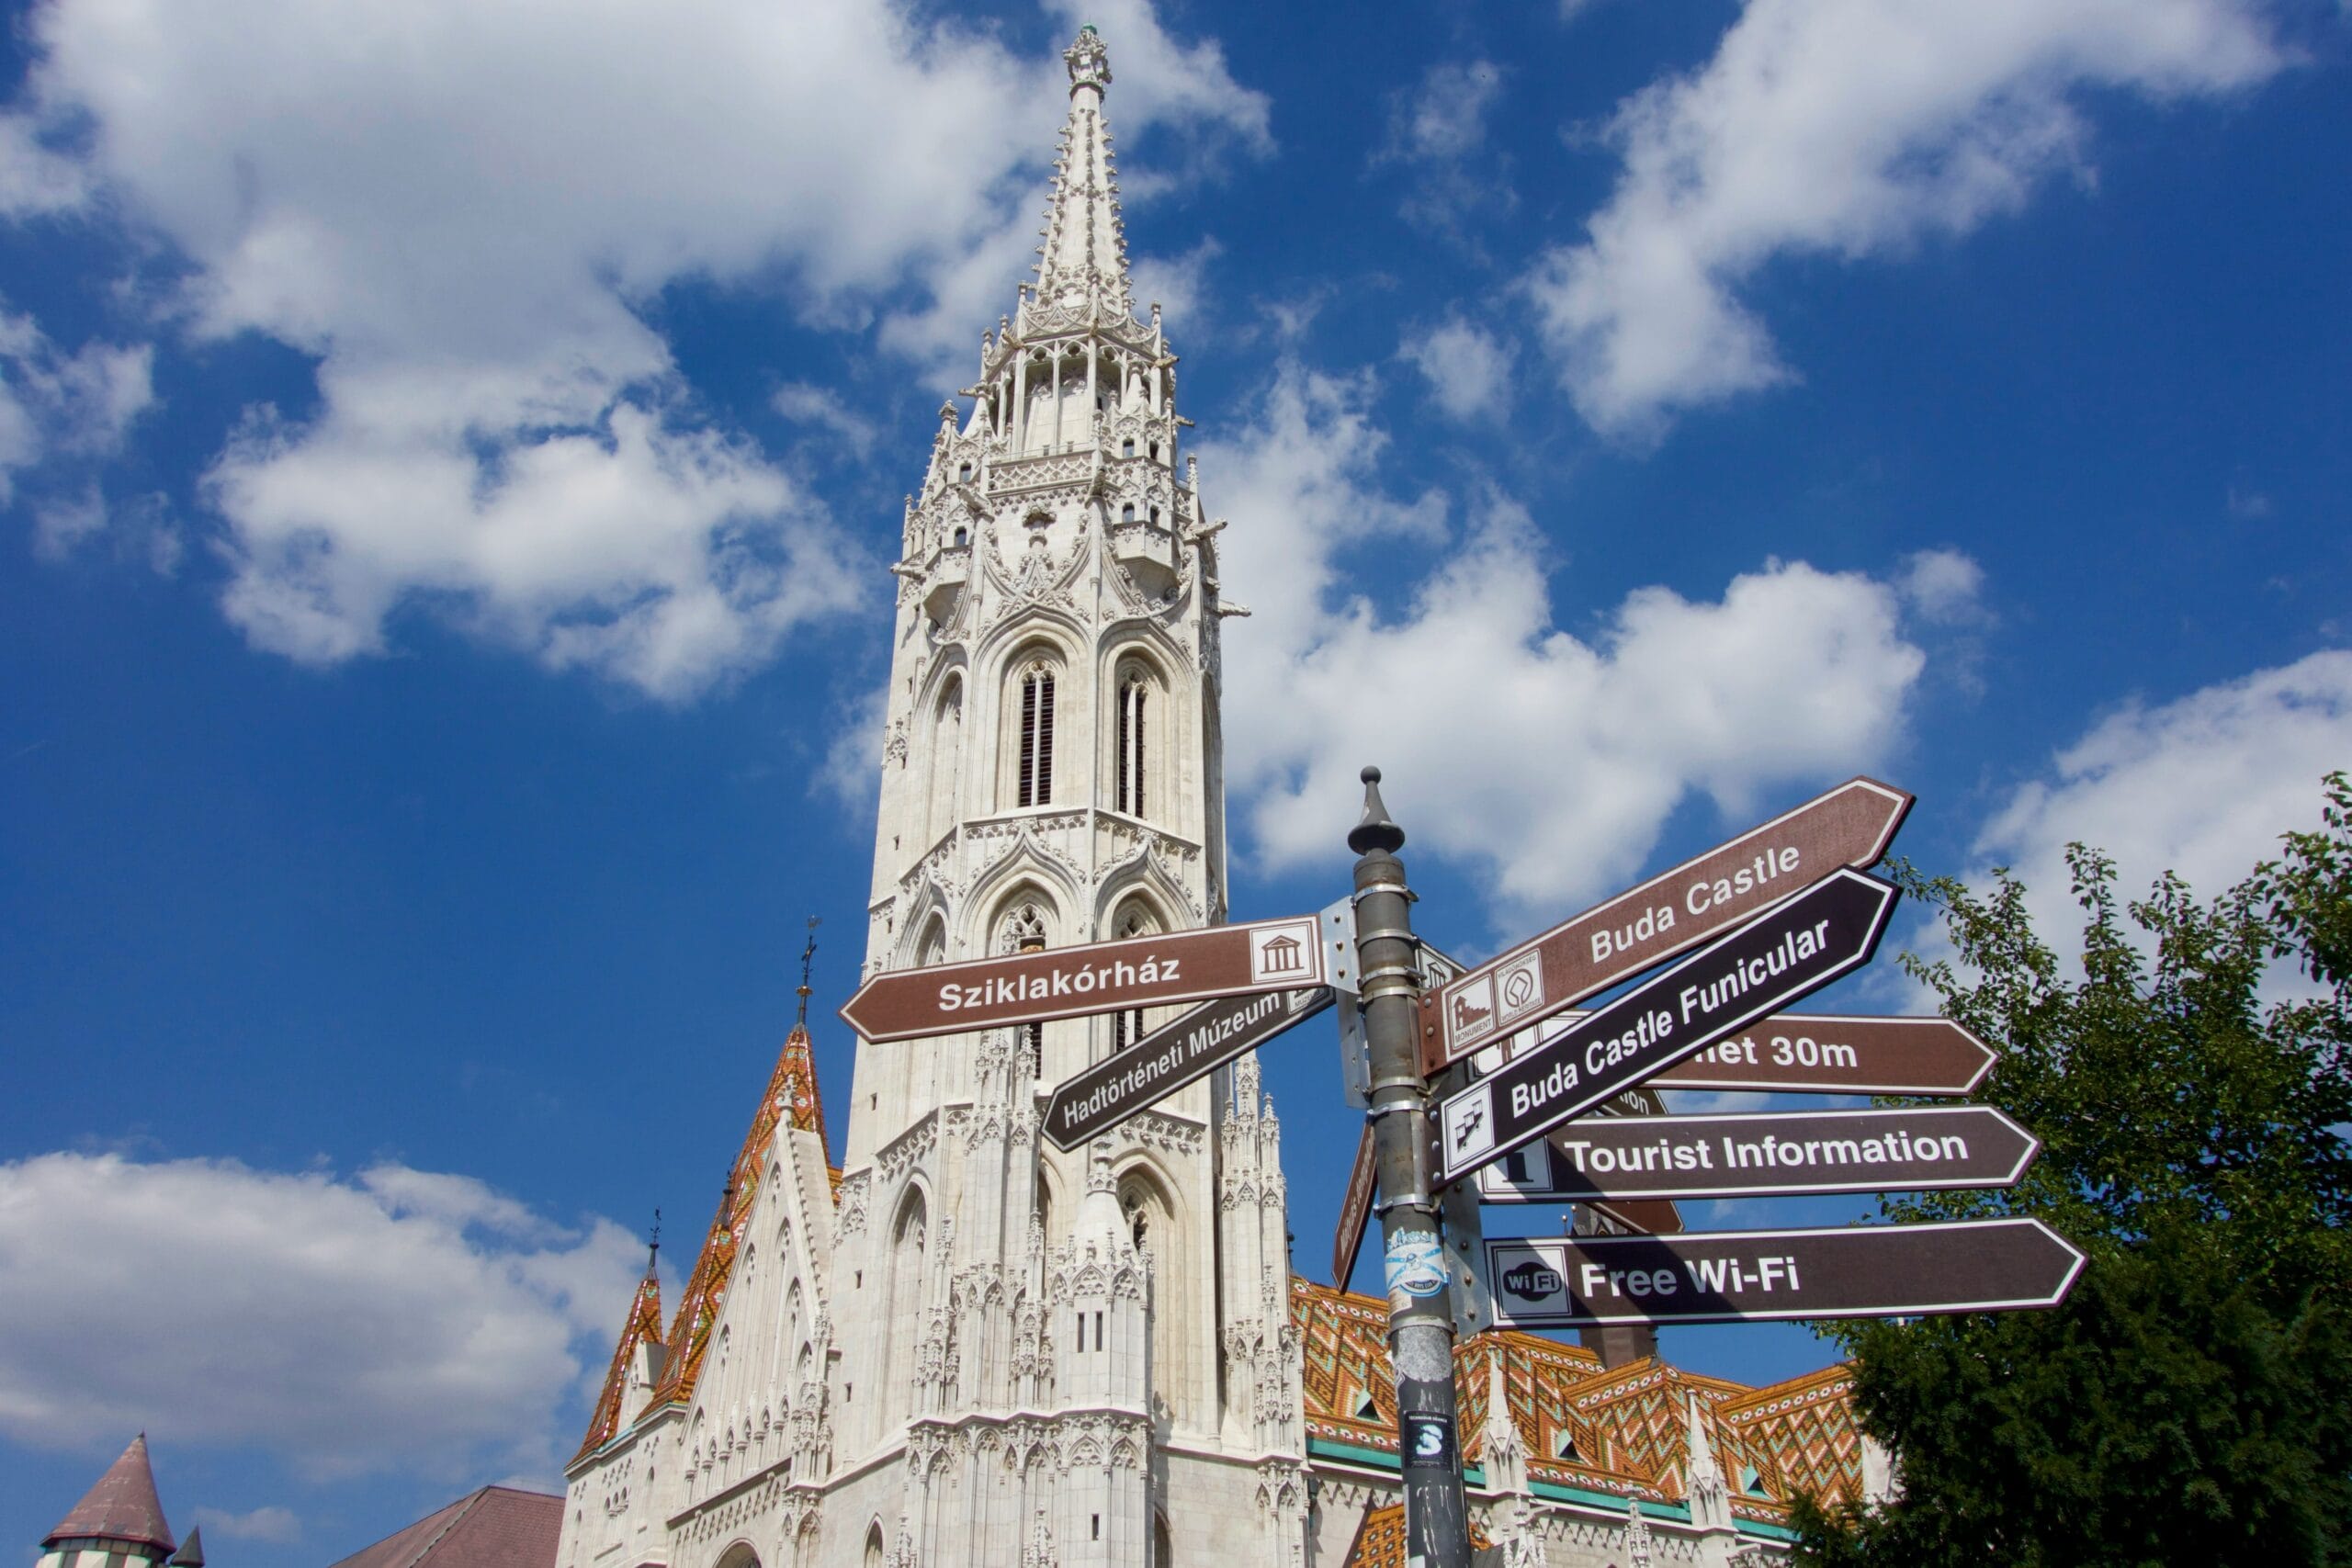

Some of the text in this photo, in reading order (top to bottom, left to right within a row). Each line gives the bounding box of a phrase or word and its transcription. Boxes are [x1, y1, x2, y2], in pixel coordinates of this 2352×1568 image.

[1589, 845, 1800, 963] Buda Castle
[939, 957, 1180, 1011] Sziklakórház
[1455, 1018, 1492, 1043] MONUMENT
[1511, 919, 1831, 1118] Buda Castle Funicular
[1064, 993, 1280, 1129] Hadtörténeti Múzeum
[1772, 1037, 1858, 1067] 30m
[1564, 1130, 1968, 1173] Tourist Information
[1581, 1256, 1800, 1297] Free Wi-Fi
